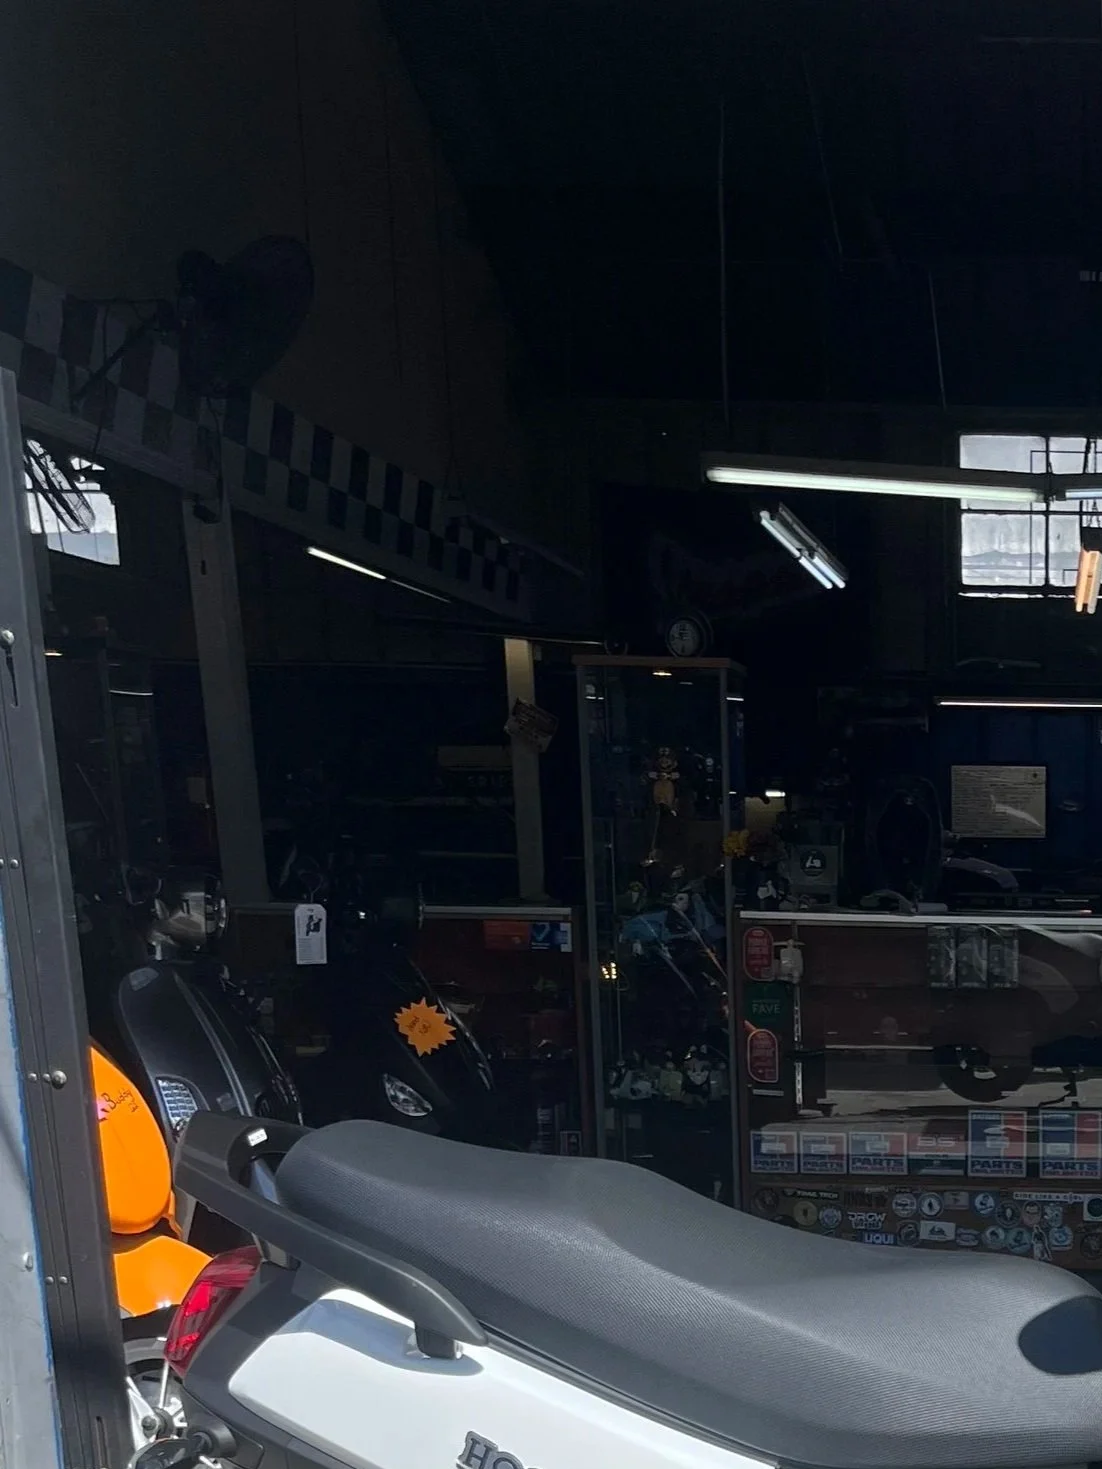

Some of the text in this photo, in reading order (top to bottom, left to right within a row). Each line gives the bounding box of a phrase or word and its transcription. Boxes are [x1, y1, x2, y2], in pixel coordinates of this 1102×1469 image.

[751, 1003, 781, 1016] FAVE
[851, 1157, 904, 1166] PARTS
[970, 1160, 1024, 1169] PARTS
[1041, 1161, 1099, 1170] PARTS
